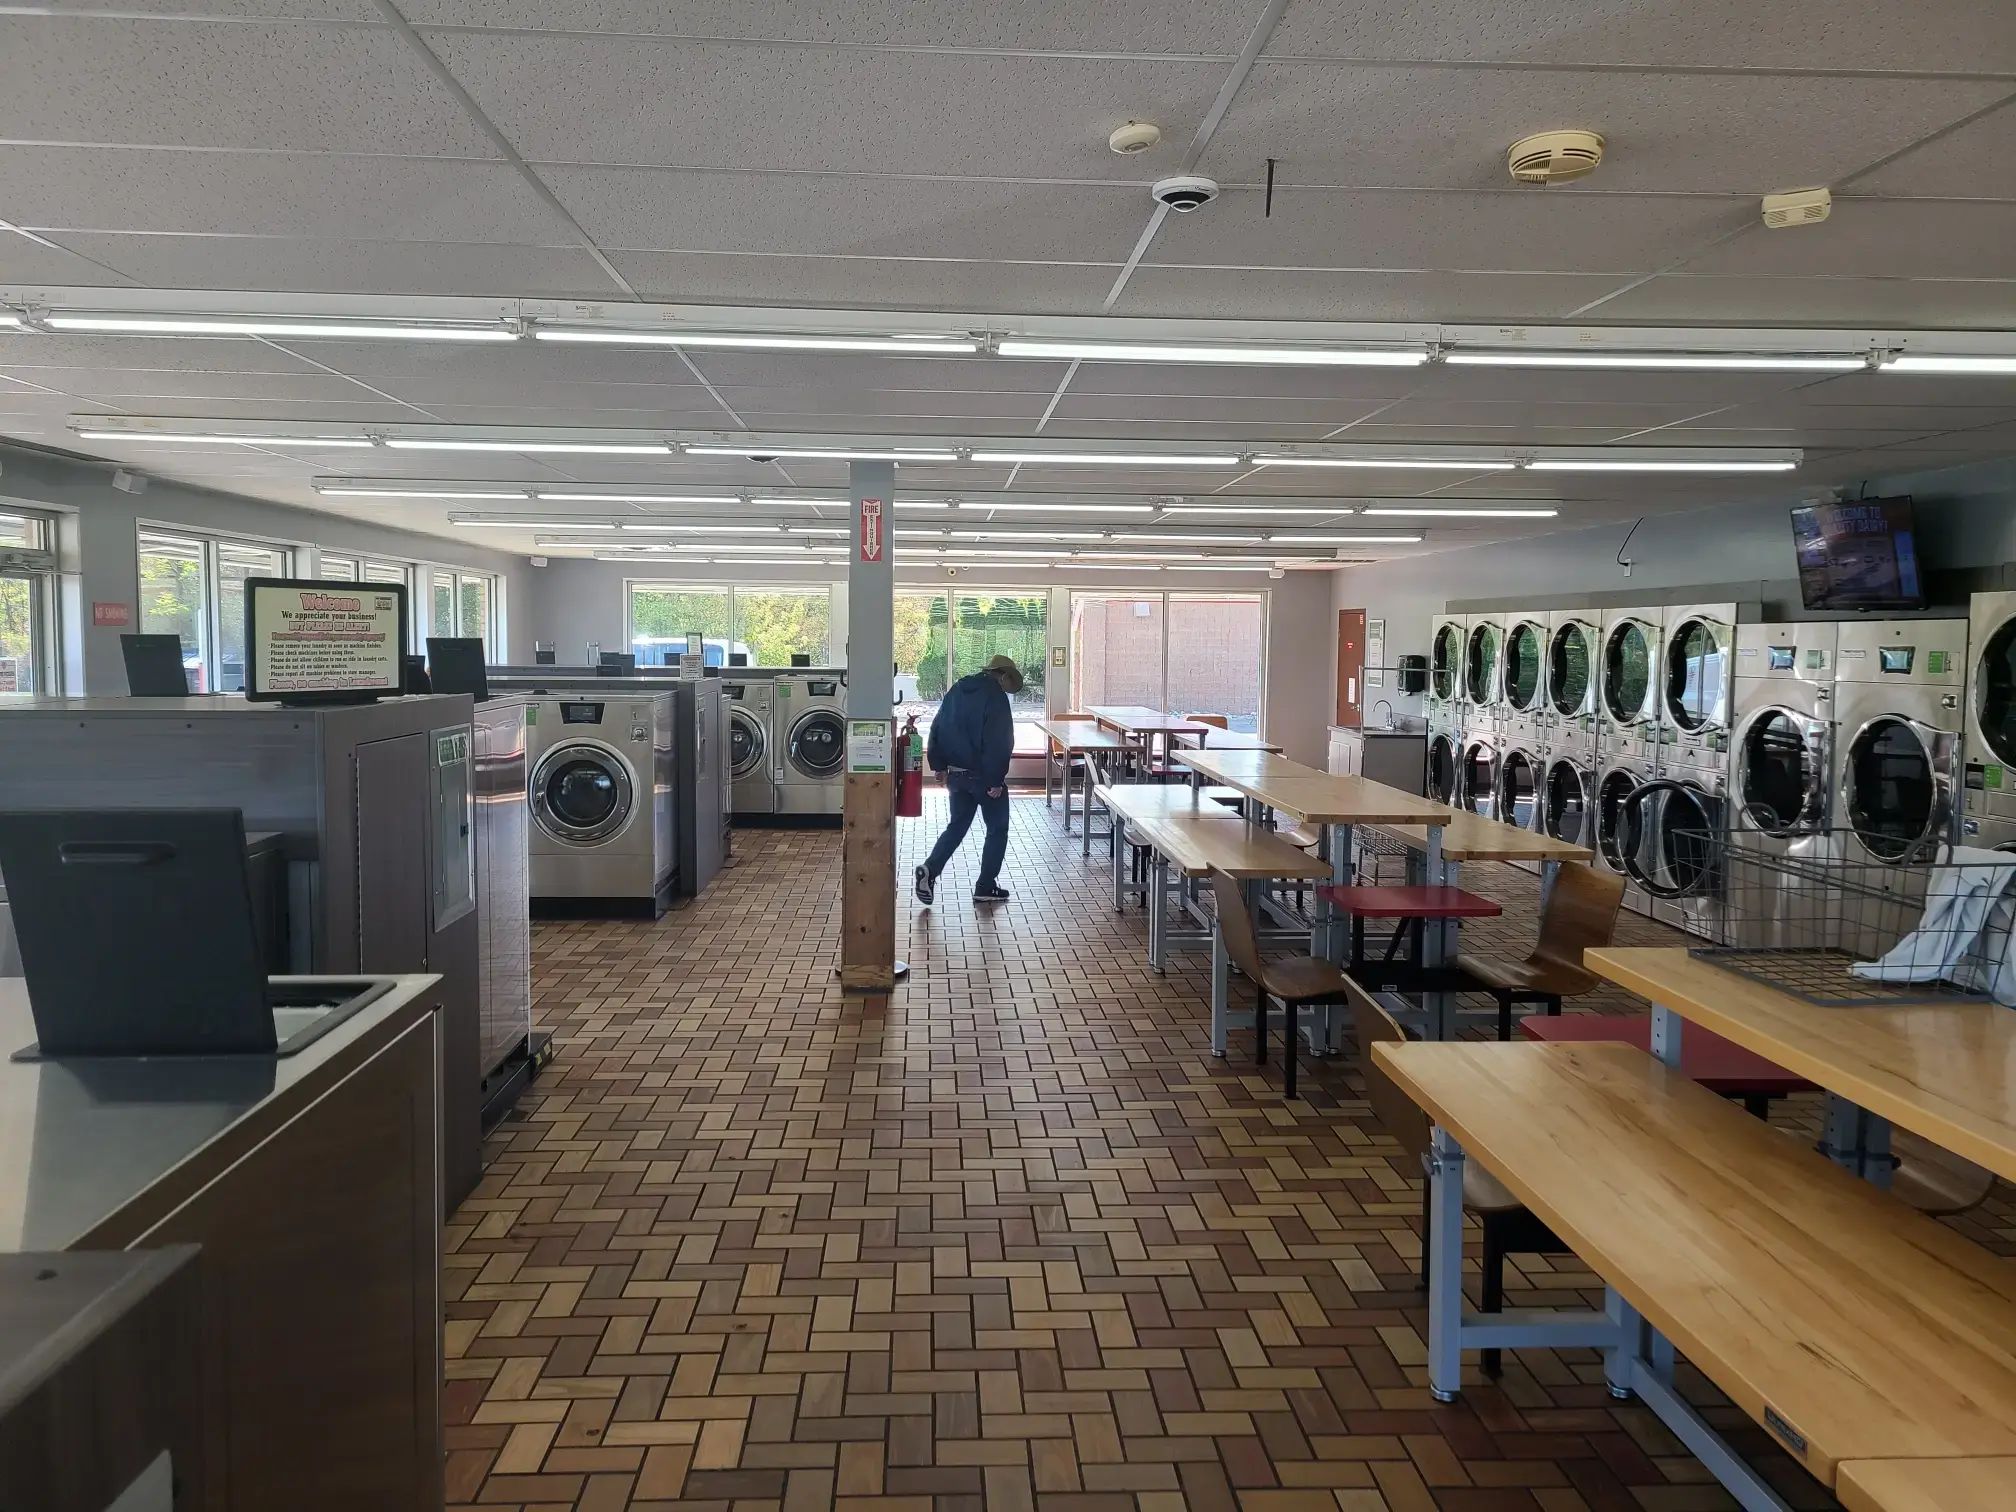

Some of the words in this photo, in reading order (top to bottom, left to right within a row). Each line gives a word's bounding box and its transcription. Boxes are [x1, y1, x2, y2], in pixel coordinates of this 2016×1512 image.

[865, 505, 879, 513] FIRE
[300, 593, 361, 611] Welcome
[95, 607, 103, 619] NO
[281, 610, 293, 619] We
[295, 611, 330, 621] appreciate
[332, 613, 346, 621] your
[348, 612, 377, 621] business!
